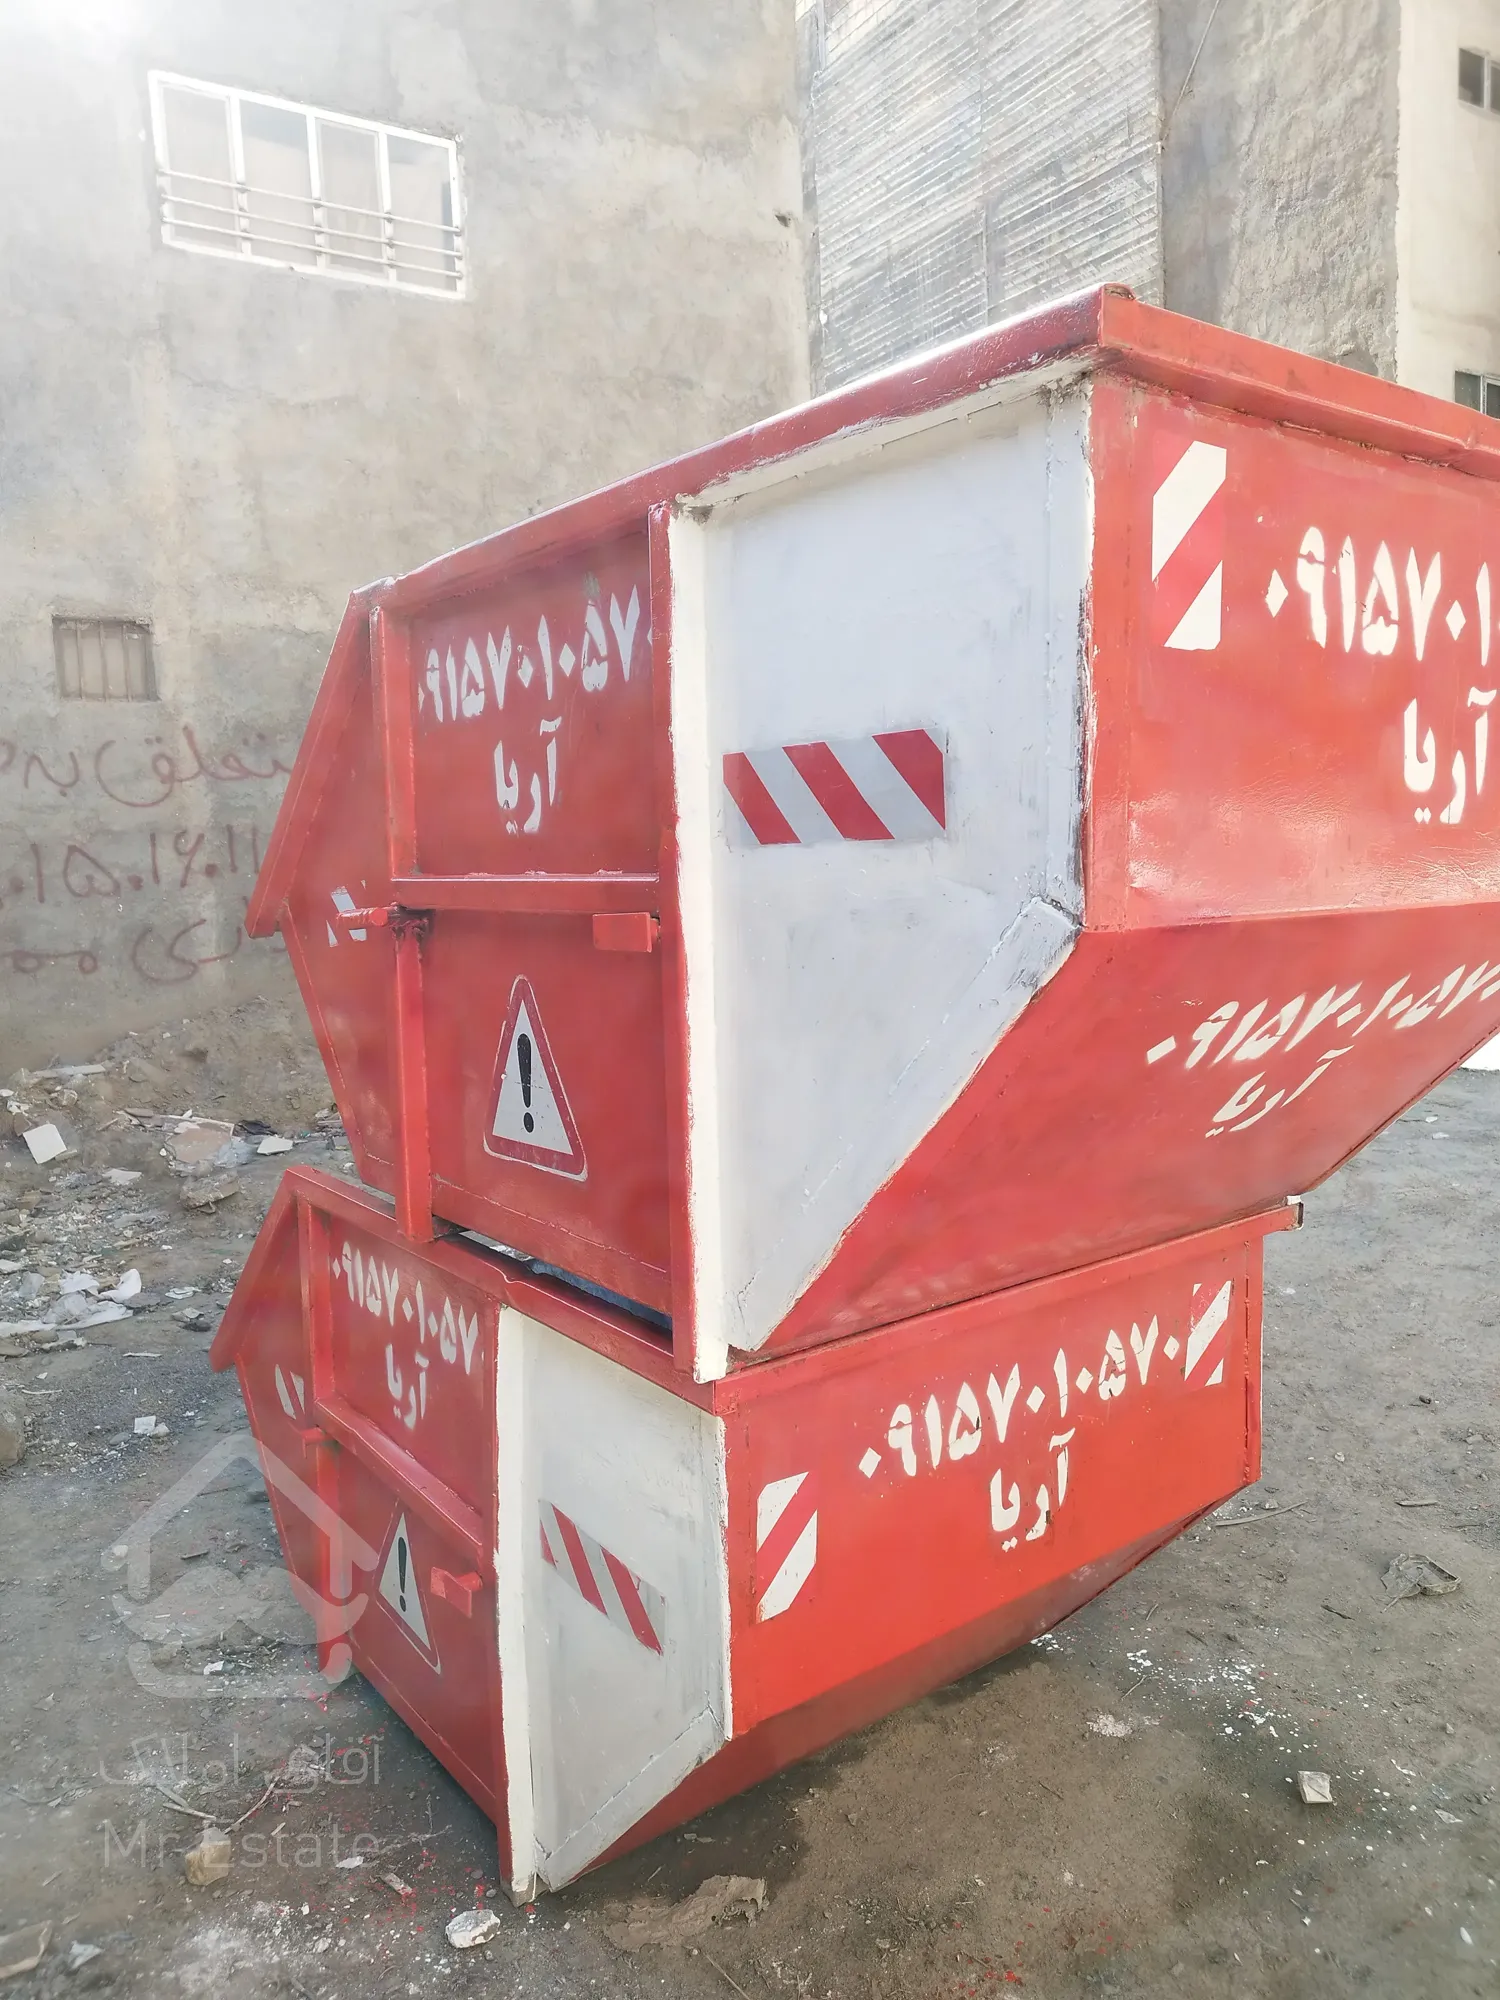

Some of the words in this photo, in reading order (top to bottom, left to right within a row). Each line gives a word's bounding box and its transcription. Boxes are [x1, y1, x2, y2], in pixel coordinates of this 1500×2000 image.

[418, 584, 652, 723] ۰۹۱۵۷۰۱۰۵۷
[1265, 526, 1500, 667] ۰۹۱۵۷۰۱
[94, 725, 293, 808] تعلق
[494, 716, 562, 833] آریا
[1404, 687, 1497, 824] آریا
[1205, 1045, 1354, 1138] آریا
[385, 1343, 429, 1430] آریا
[858, 1314, 1180, 1478] ۰۹۱۵۷۰۱۰۵۷۰
[990, 1427, 1075, 1552] آریا
